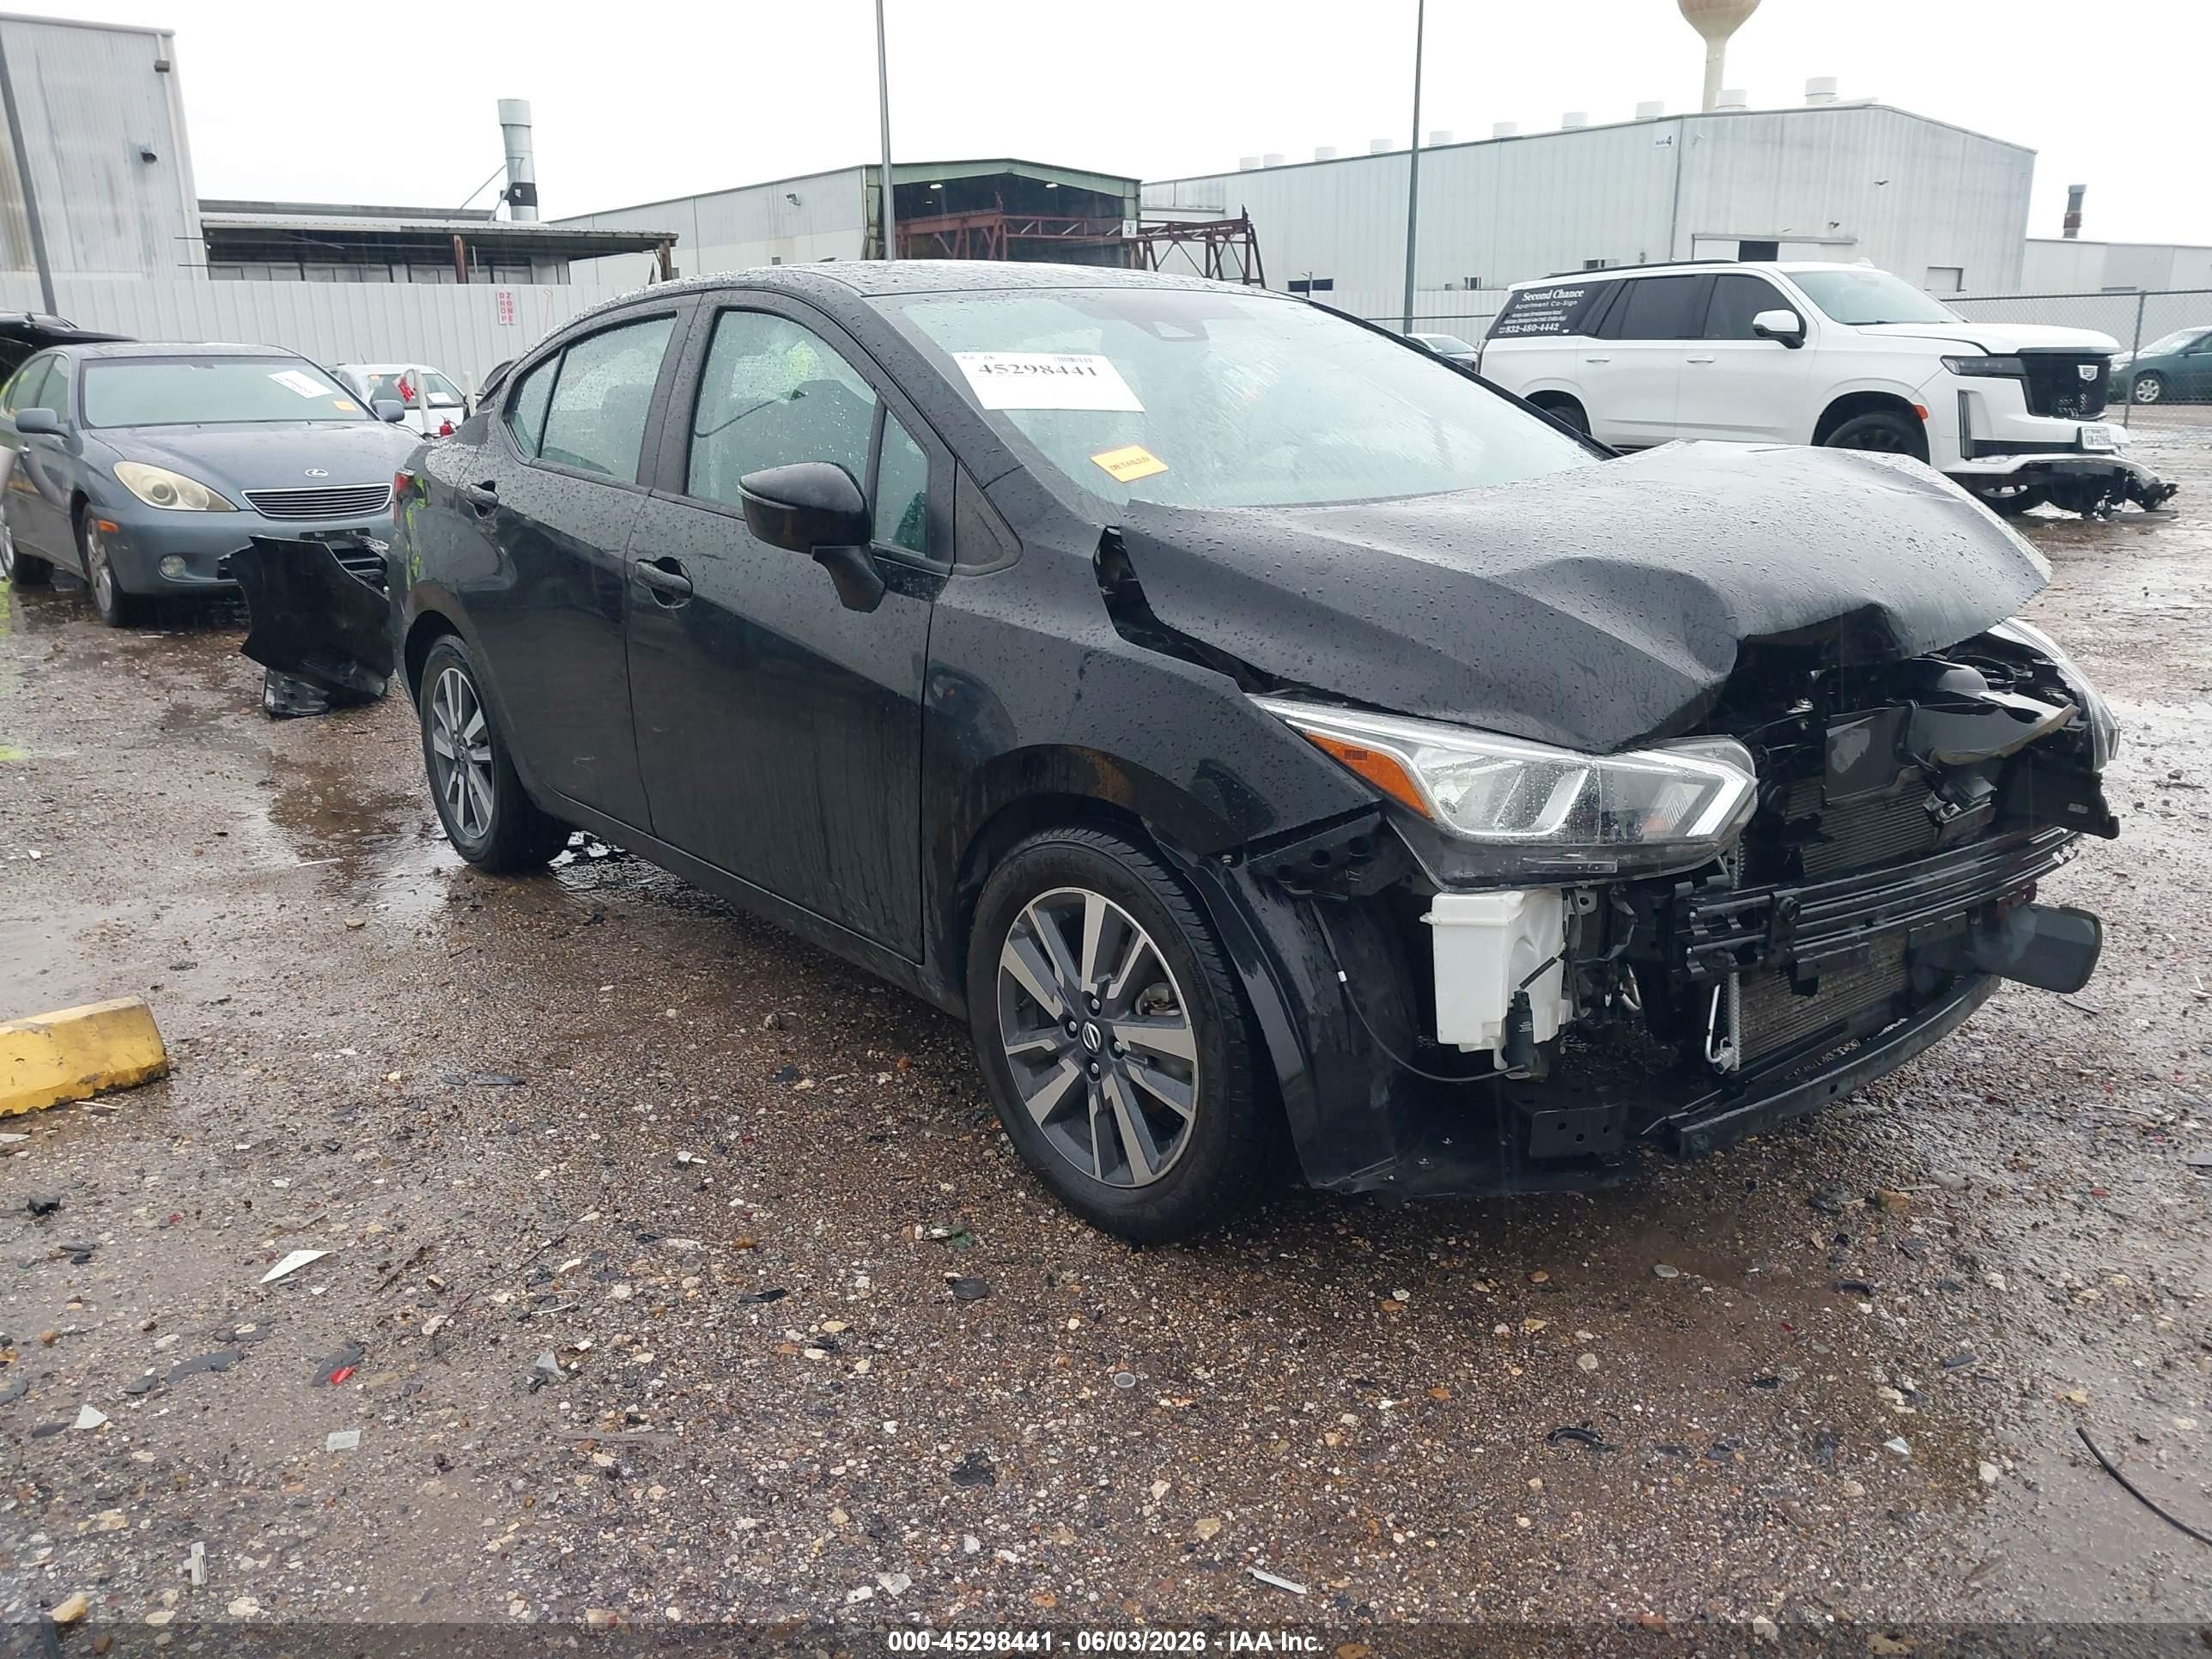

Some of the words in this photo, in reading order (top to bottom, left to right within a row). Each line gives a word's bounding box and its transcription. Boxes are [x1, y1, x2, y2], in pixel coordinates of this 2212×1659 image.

[1666, 135, 1672, 146] 4
[1522, 289, 1553, 301] Second
[1553, 288, 1585, 299] Chance
[1514, 301, 1549, 310] Apartment
[978, 364, 1097, 377] 45298441
